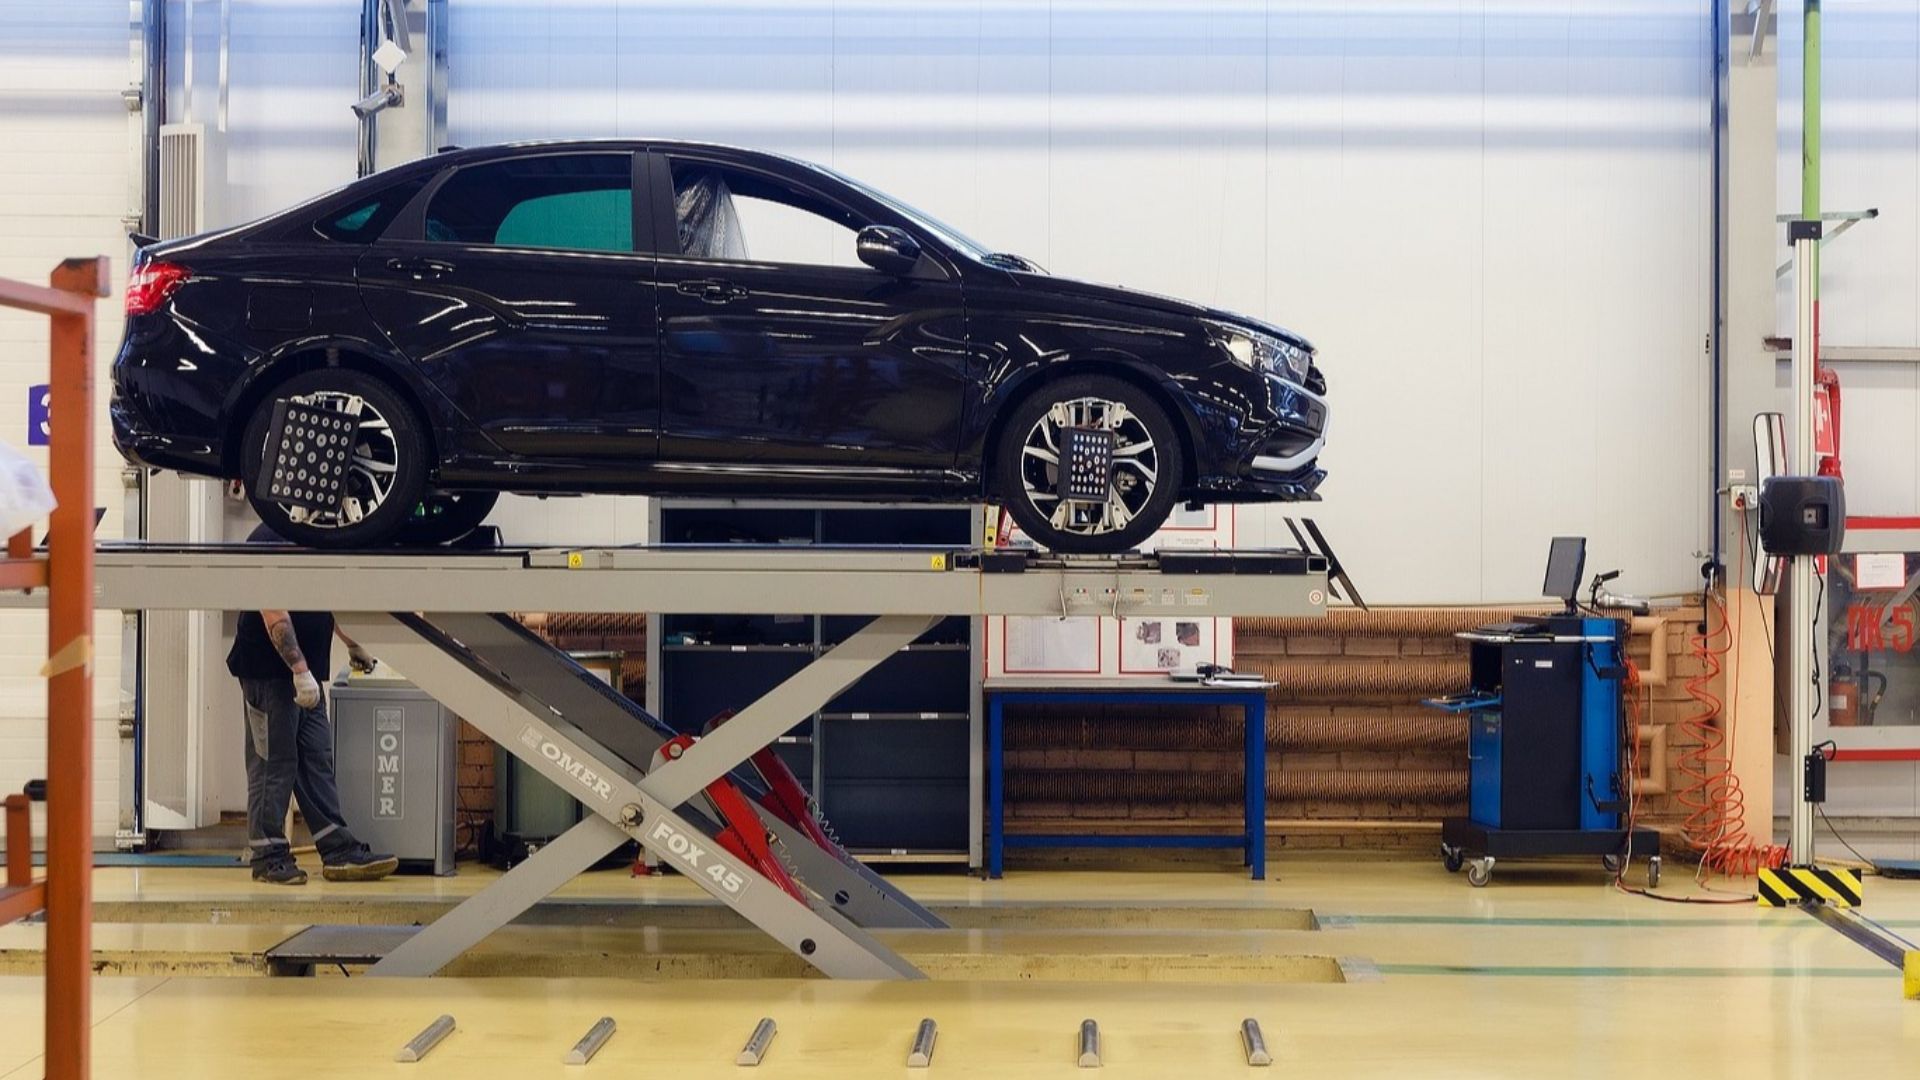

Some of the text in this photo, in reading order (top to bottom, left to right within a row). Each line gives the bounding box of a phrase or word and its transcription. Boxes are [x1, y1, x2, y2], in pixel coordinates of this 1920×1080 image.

[1892, 605, 1914, 653] 5
[378, 733, 399, 815] OMER
[541, 742, 612, 800] OMER
[652, 822, 743, 893] FOX 45
